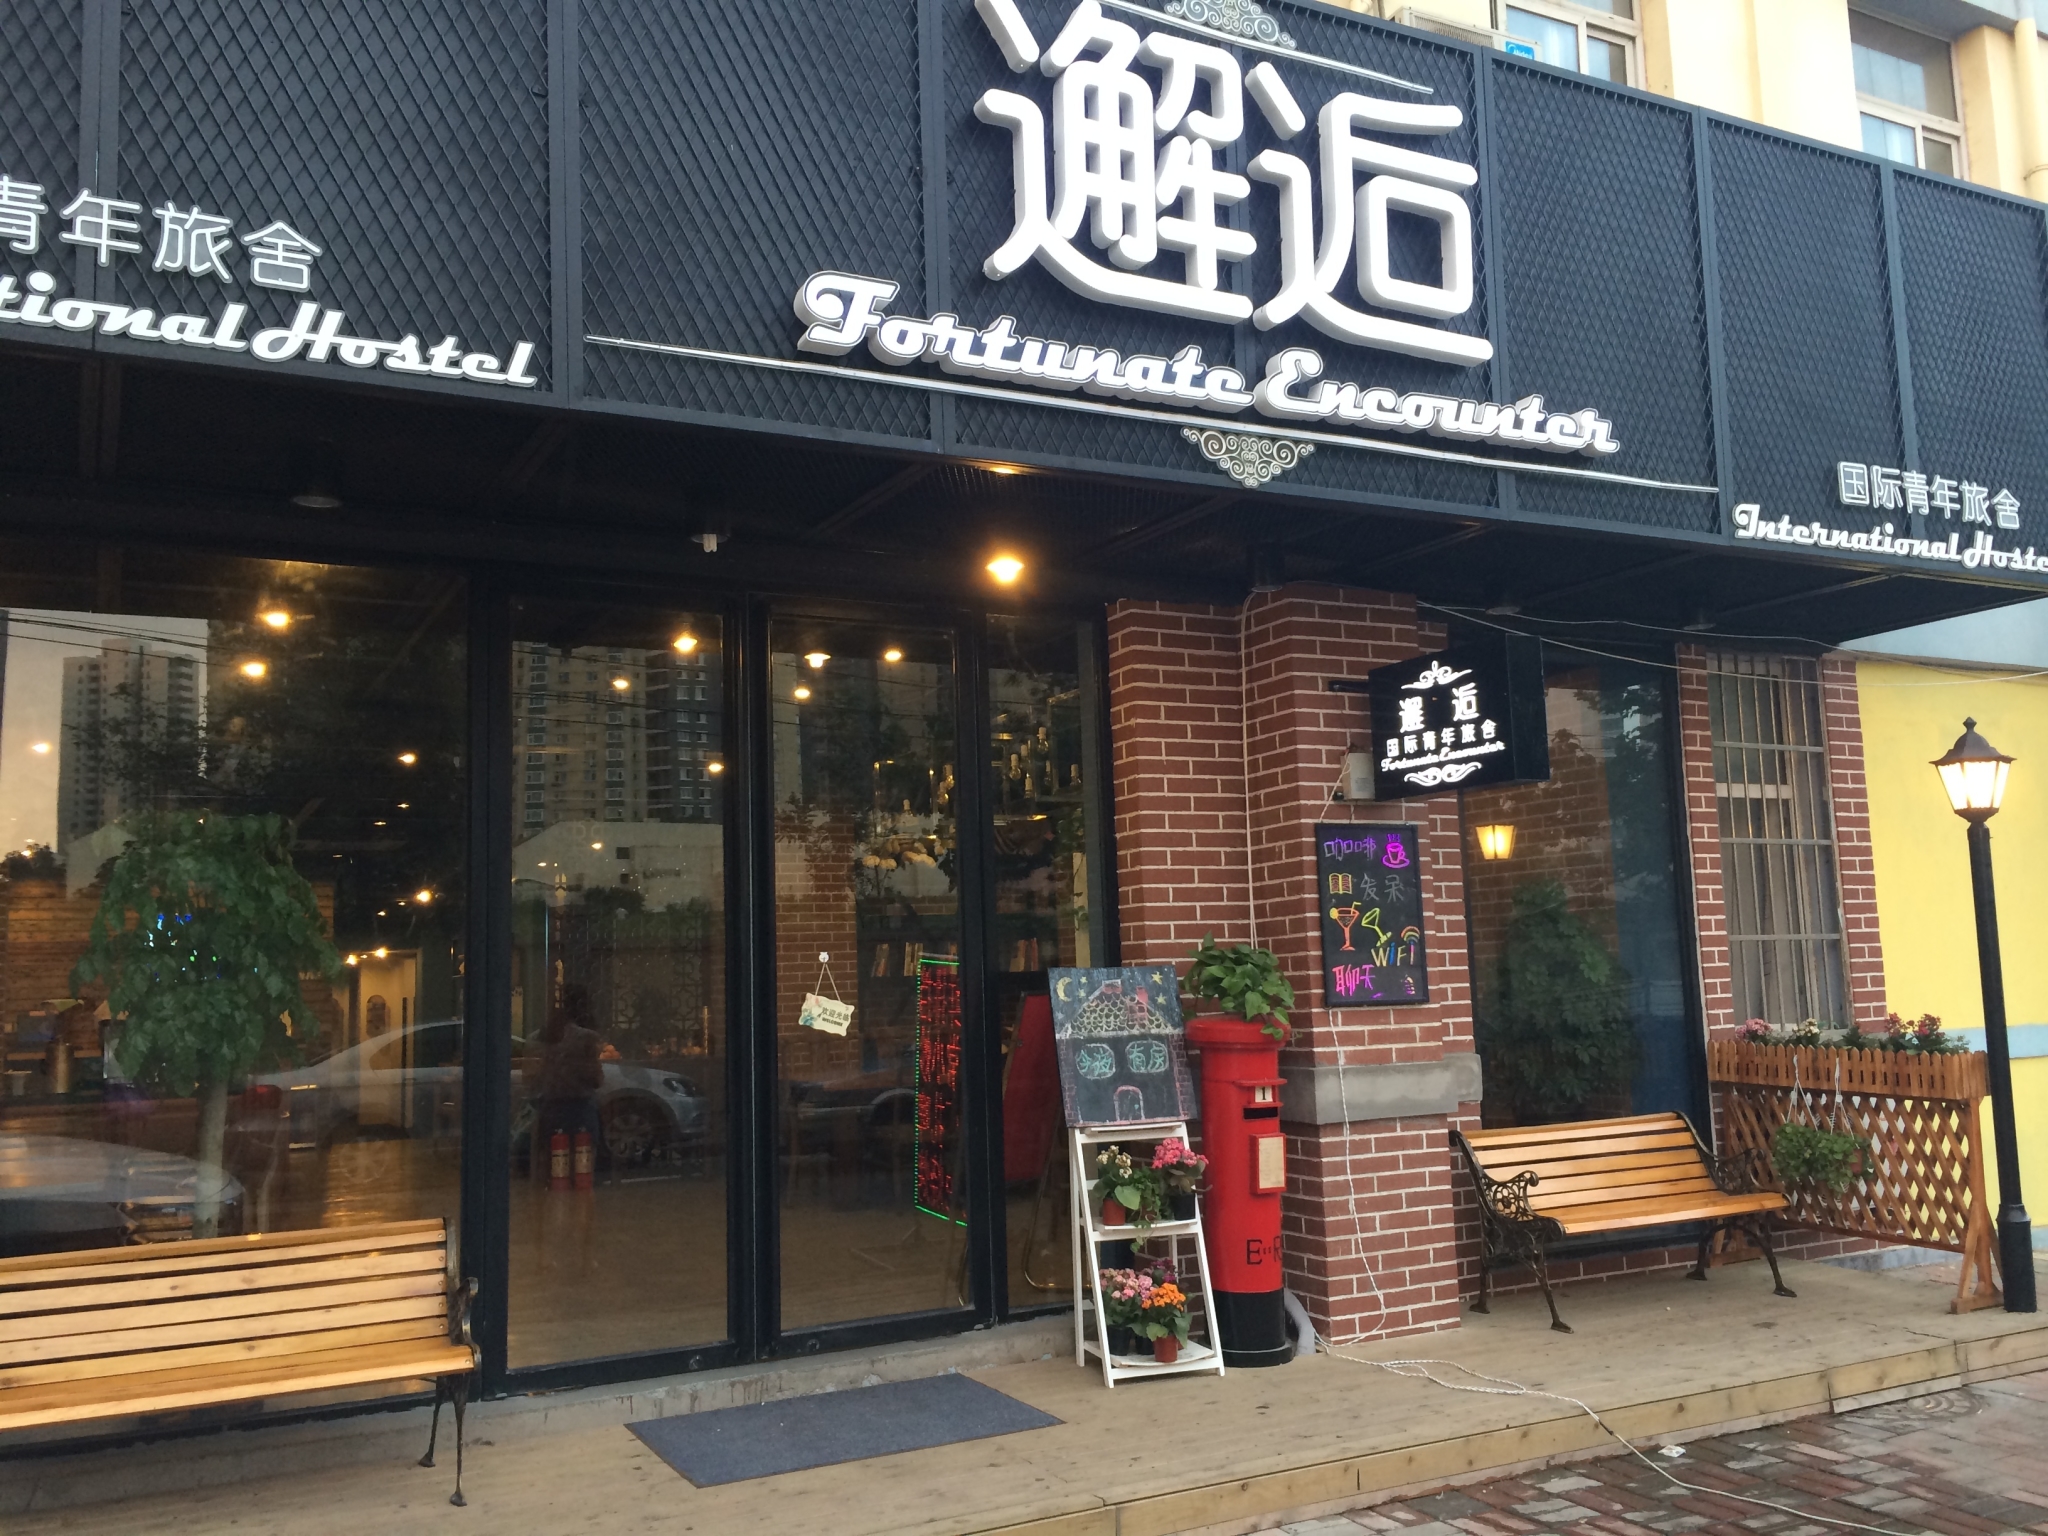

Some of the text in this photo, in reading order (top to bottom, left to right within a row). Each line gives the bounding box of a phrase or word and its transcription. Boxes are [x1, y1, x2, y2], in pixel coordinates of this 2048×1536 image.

[974, 0, 1493, 366] 邂逅
[250, 301, 537, 387] Hostel
[795, 270, 1620, 456] Fortunate Encounter
[1733, 502, 1962, 562] International
[1837, 461, 2021, 530] 国际青年旅舍
[1332, 964, 1376, 997] 聊天
